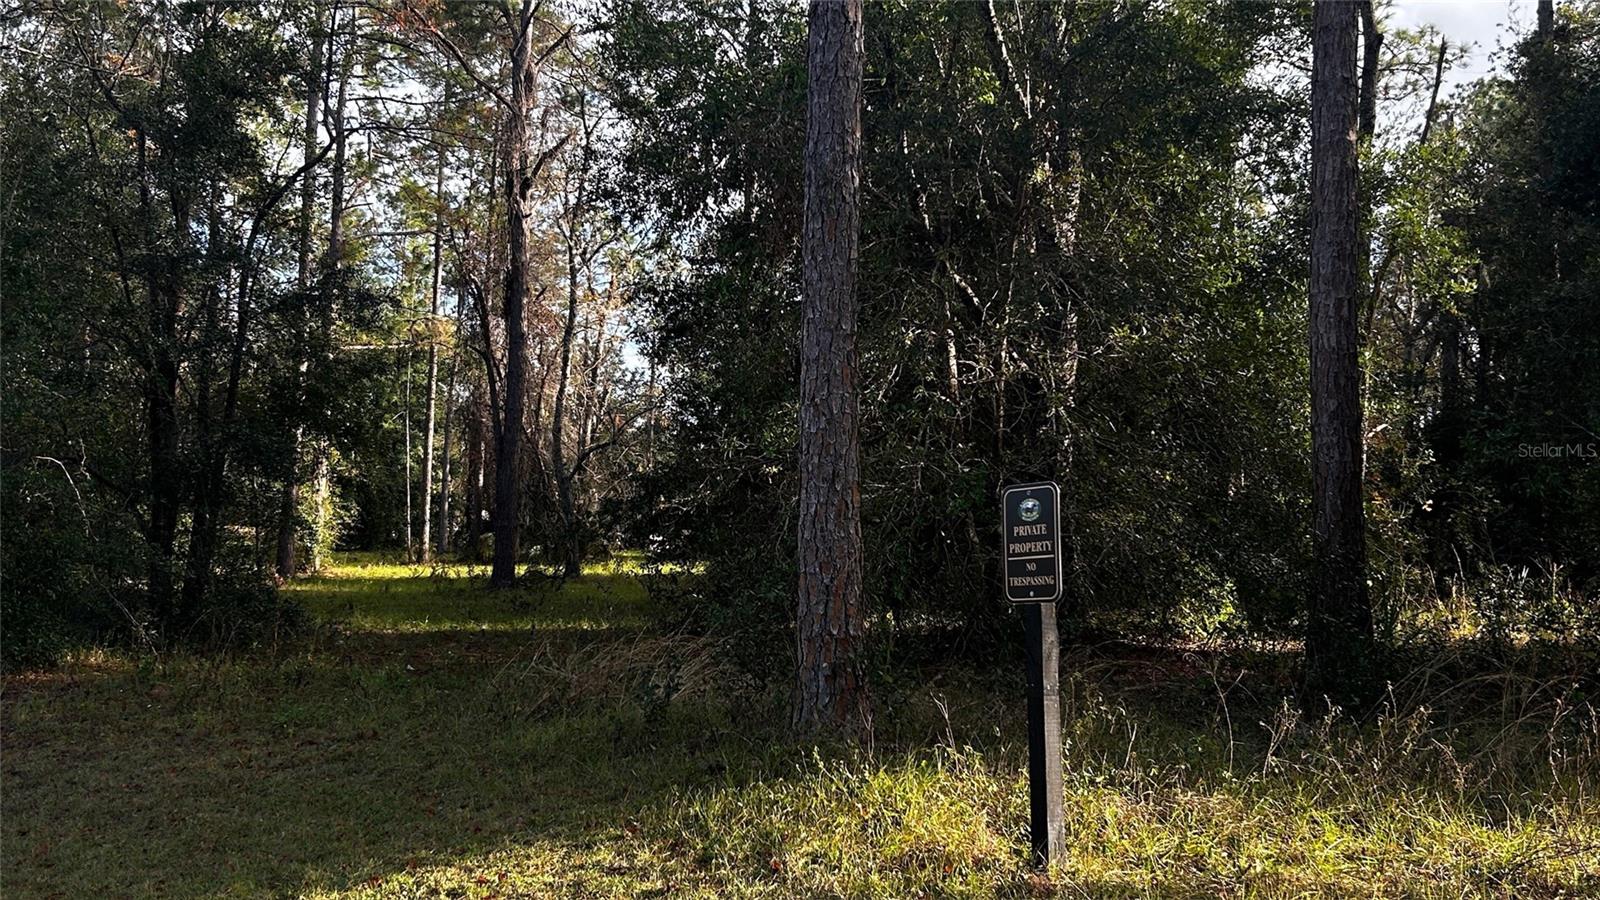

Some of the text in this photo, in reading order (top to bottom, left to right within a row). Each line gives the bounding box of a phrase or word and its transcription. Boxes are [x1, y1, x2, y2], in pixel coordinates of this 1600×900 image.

[1013, 524, 1047, 536] PRIVATE
[1009, 541, 1053, 553] PROPERTY
[1026, 562, 1037, 571] NO
[1009, 575, 1055, 586] TRESPASSING
